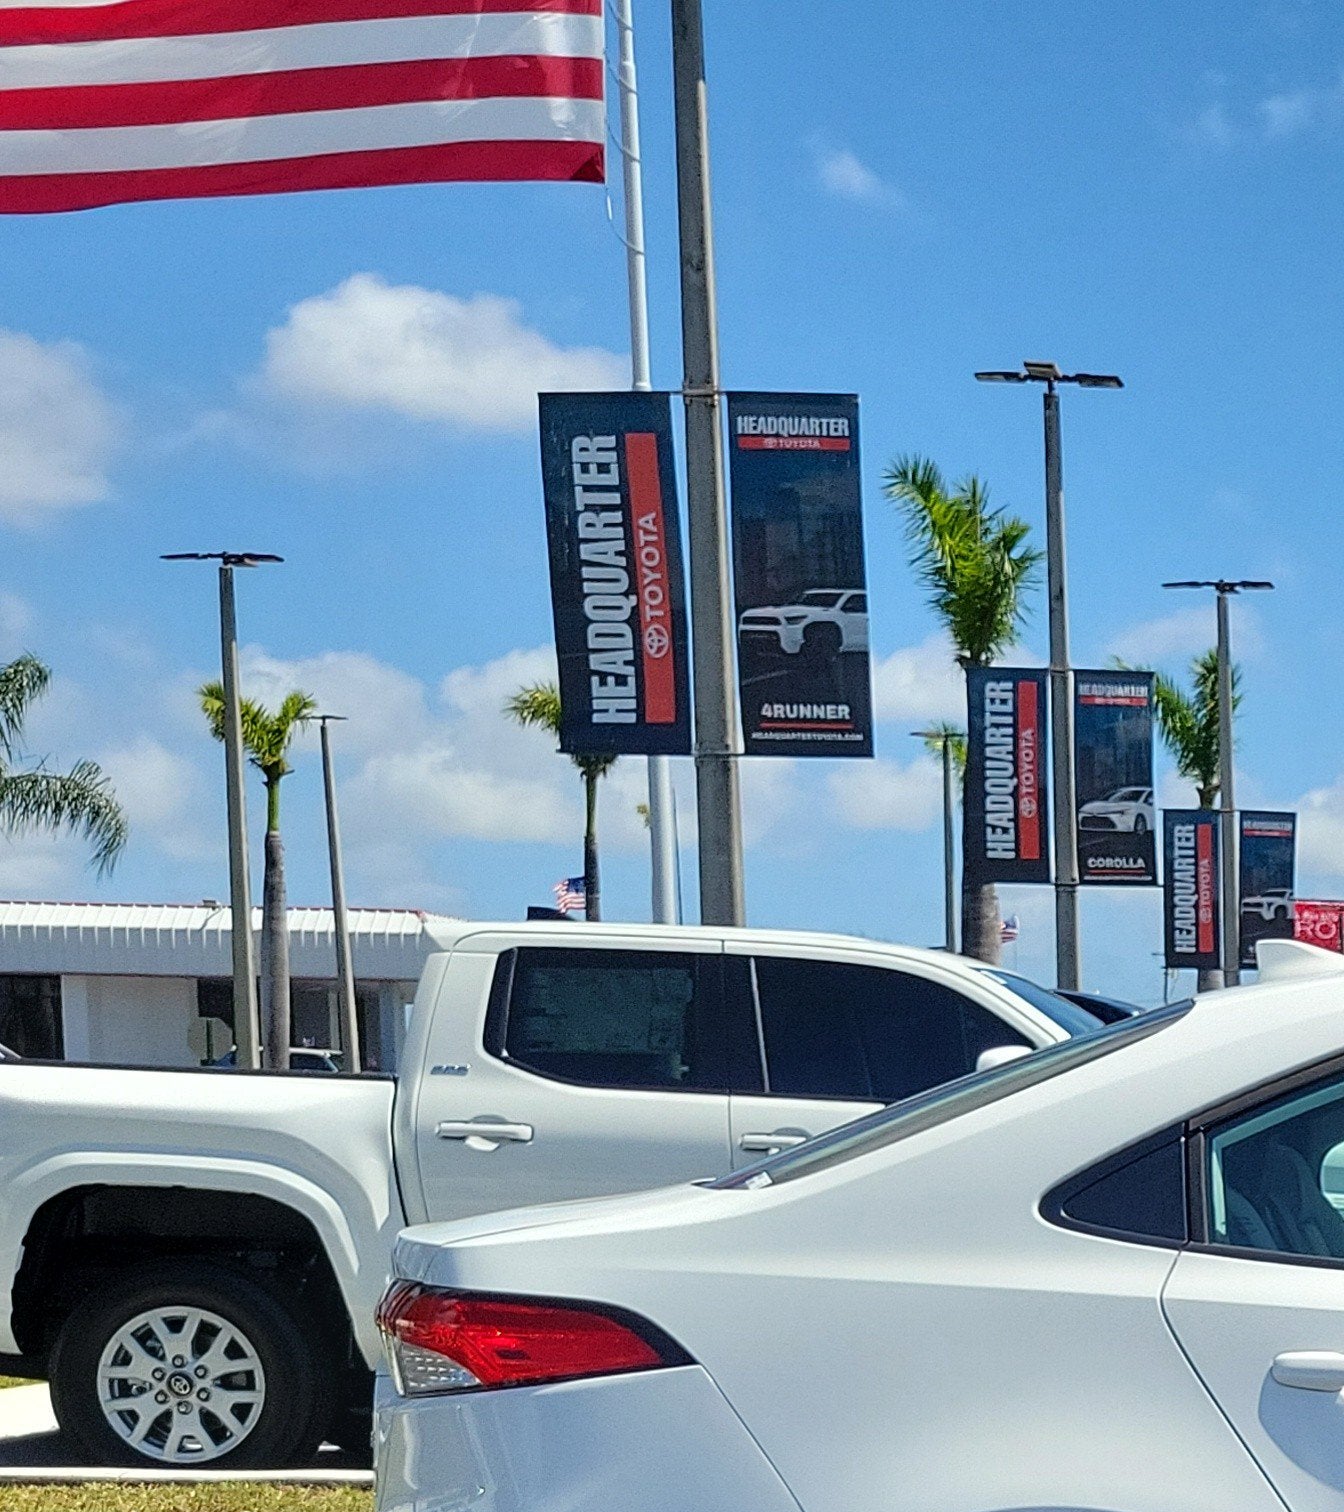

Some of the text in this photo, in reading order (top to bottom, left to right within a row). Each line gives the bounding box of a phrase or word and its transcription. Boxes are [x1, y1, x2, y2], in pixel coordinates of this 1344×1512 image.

[737, 415, 850, 437] HEADQUARTER
[778, 438, 821, 450] TOYOTA
[571, 433, 637, 724] HEADQUARTER
[638, 511, 665, 623] TOYOTA
[760, 702, 851, 720] 4RUNNER
[984, 680, 1018, 860] HEADQUARTER
[1020, 727, 1035, 795] TOYOTA
[1086, 855, 1146, 869] COROLLA
[1174, 824, 1199, 954] HEADQUARTER
[1198, 858, 1212, 907] TOYOTA
